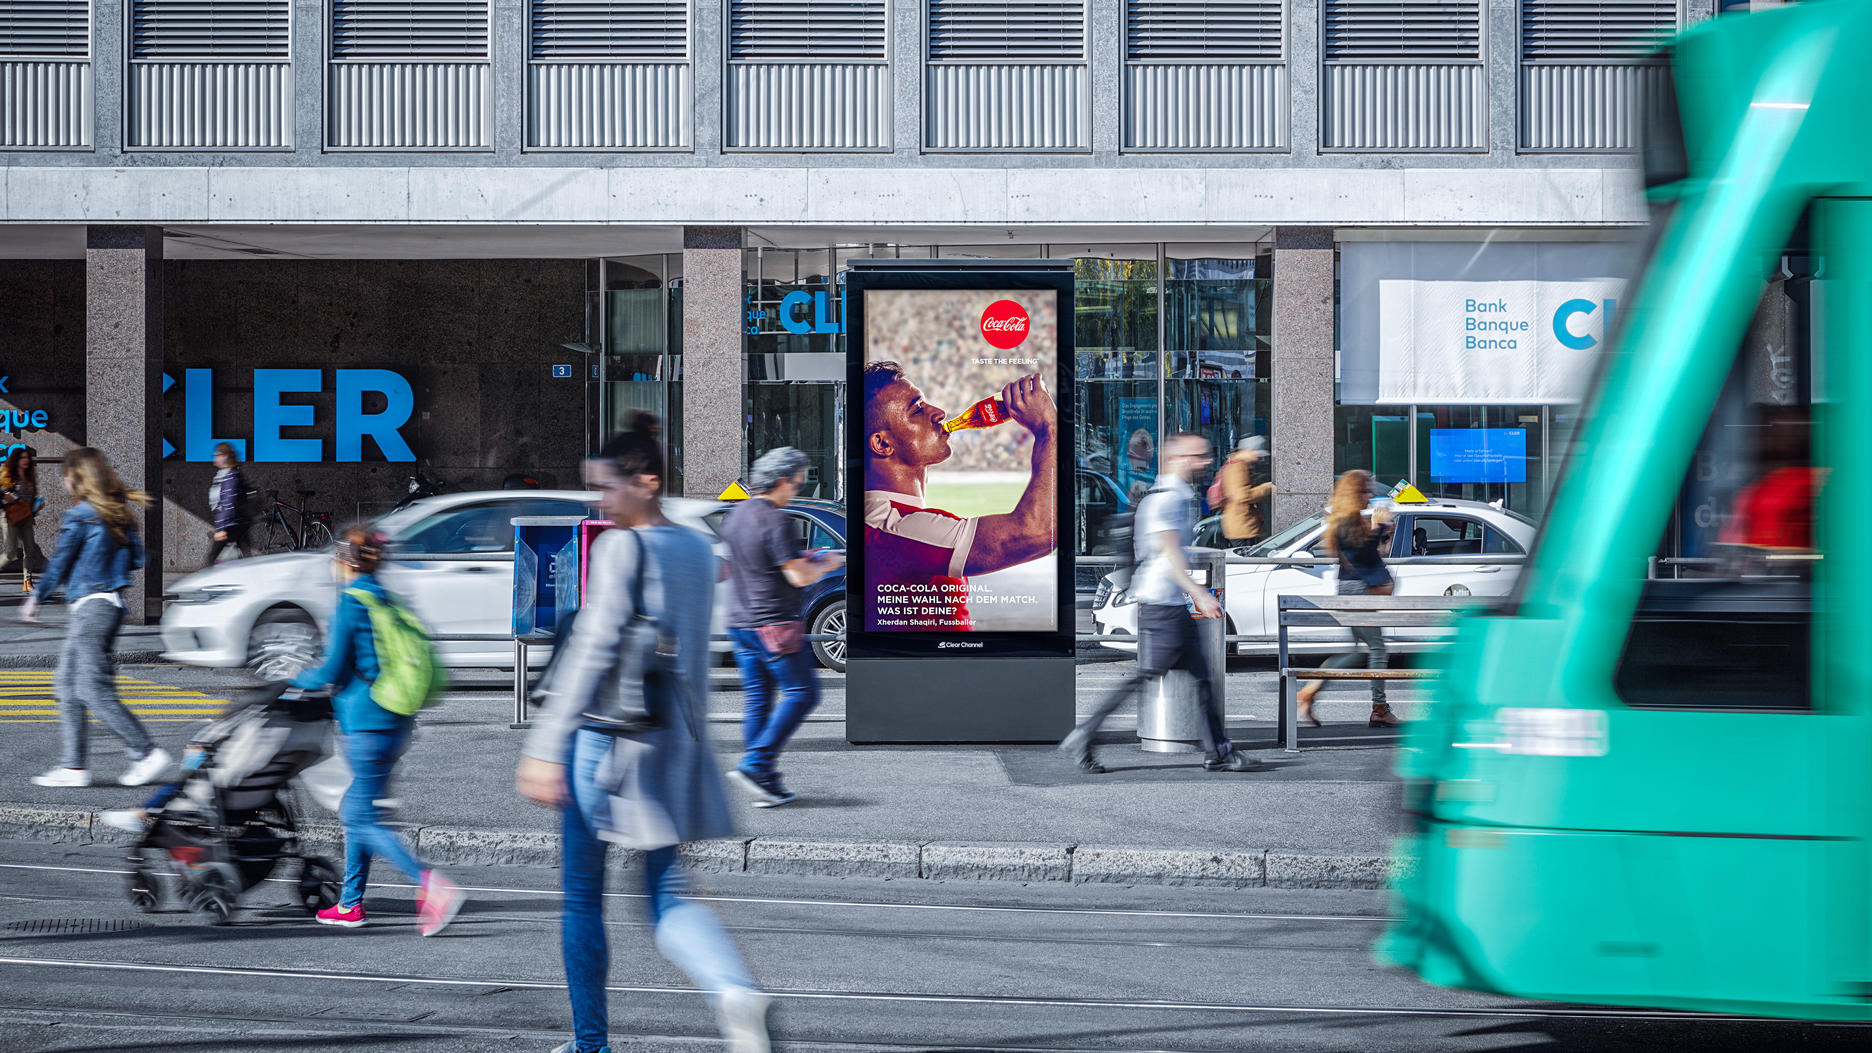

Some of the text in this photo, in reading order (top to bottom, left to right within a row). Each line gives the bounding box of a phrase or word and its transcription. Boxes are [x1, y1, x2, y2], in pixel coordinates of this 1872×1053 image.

[1465, 298, 1507, 312] Bank
[983, 317, 1028, 332] Coca-Cola
[1465, 317, 1529, 334] Banque
[1465, 336, 1517, 349] Banca
[559, 367, 565, 375] 3
[163, 368, 417, 462] LER
[877, 584, 993, 592] COCA-COLA ORIGINAL.
[877, 595, 1038, 604] MEINE WAHL NACH DEM MATCH.
[877, 607, 957, 615] WAS IST DEINE?
[877, 618, 976, 627] Xherdan Shaqiri, Fussballer
